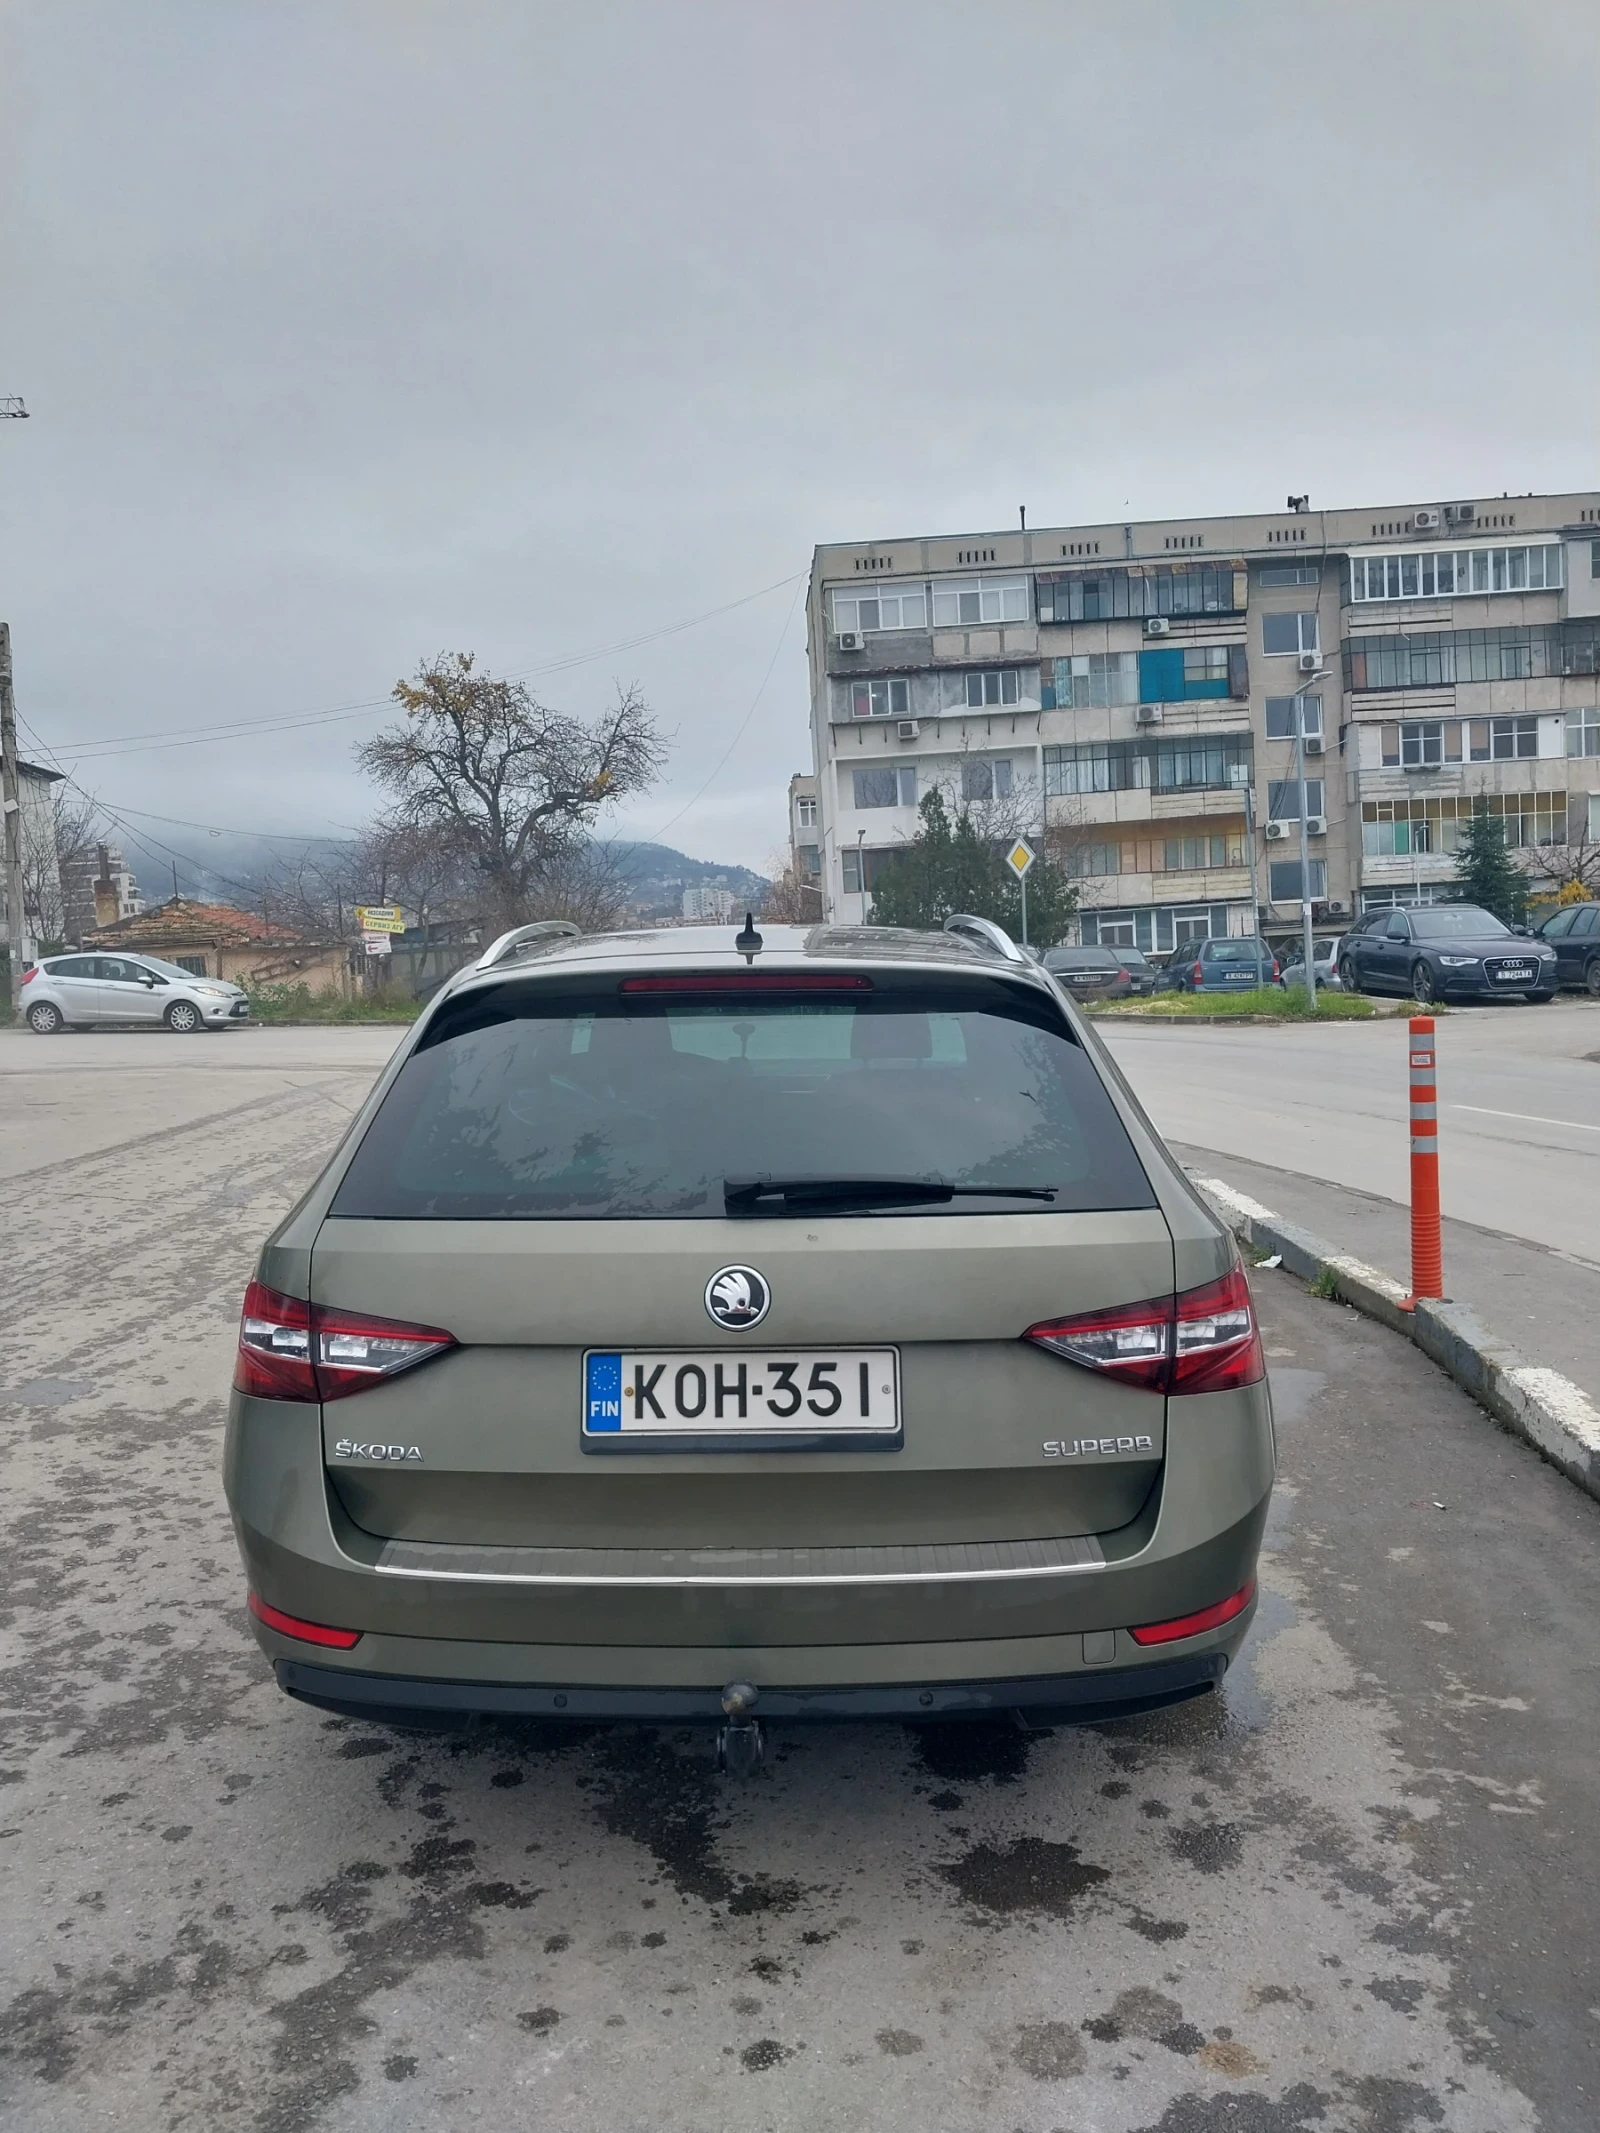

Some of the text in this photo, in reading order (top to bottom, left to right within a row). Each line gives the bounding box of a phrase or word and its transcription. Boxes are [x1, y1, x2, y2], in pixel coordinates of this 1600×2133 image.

[365, 921, 391, 929] СЕРВИЗ
[633, 1362, 870, 1419] KOH-351
[590, 1400, 619, 1417] FIN
[335, 1438, 424, 1462] ŠKODA
[1042, 1435, 1153, 1458] SUPERB
